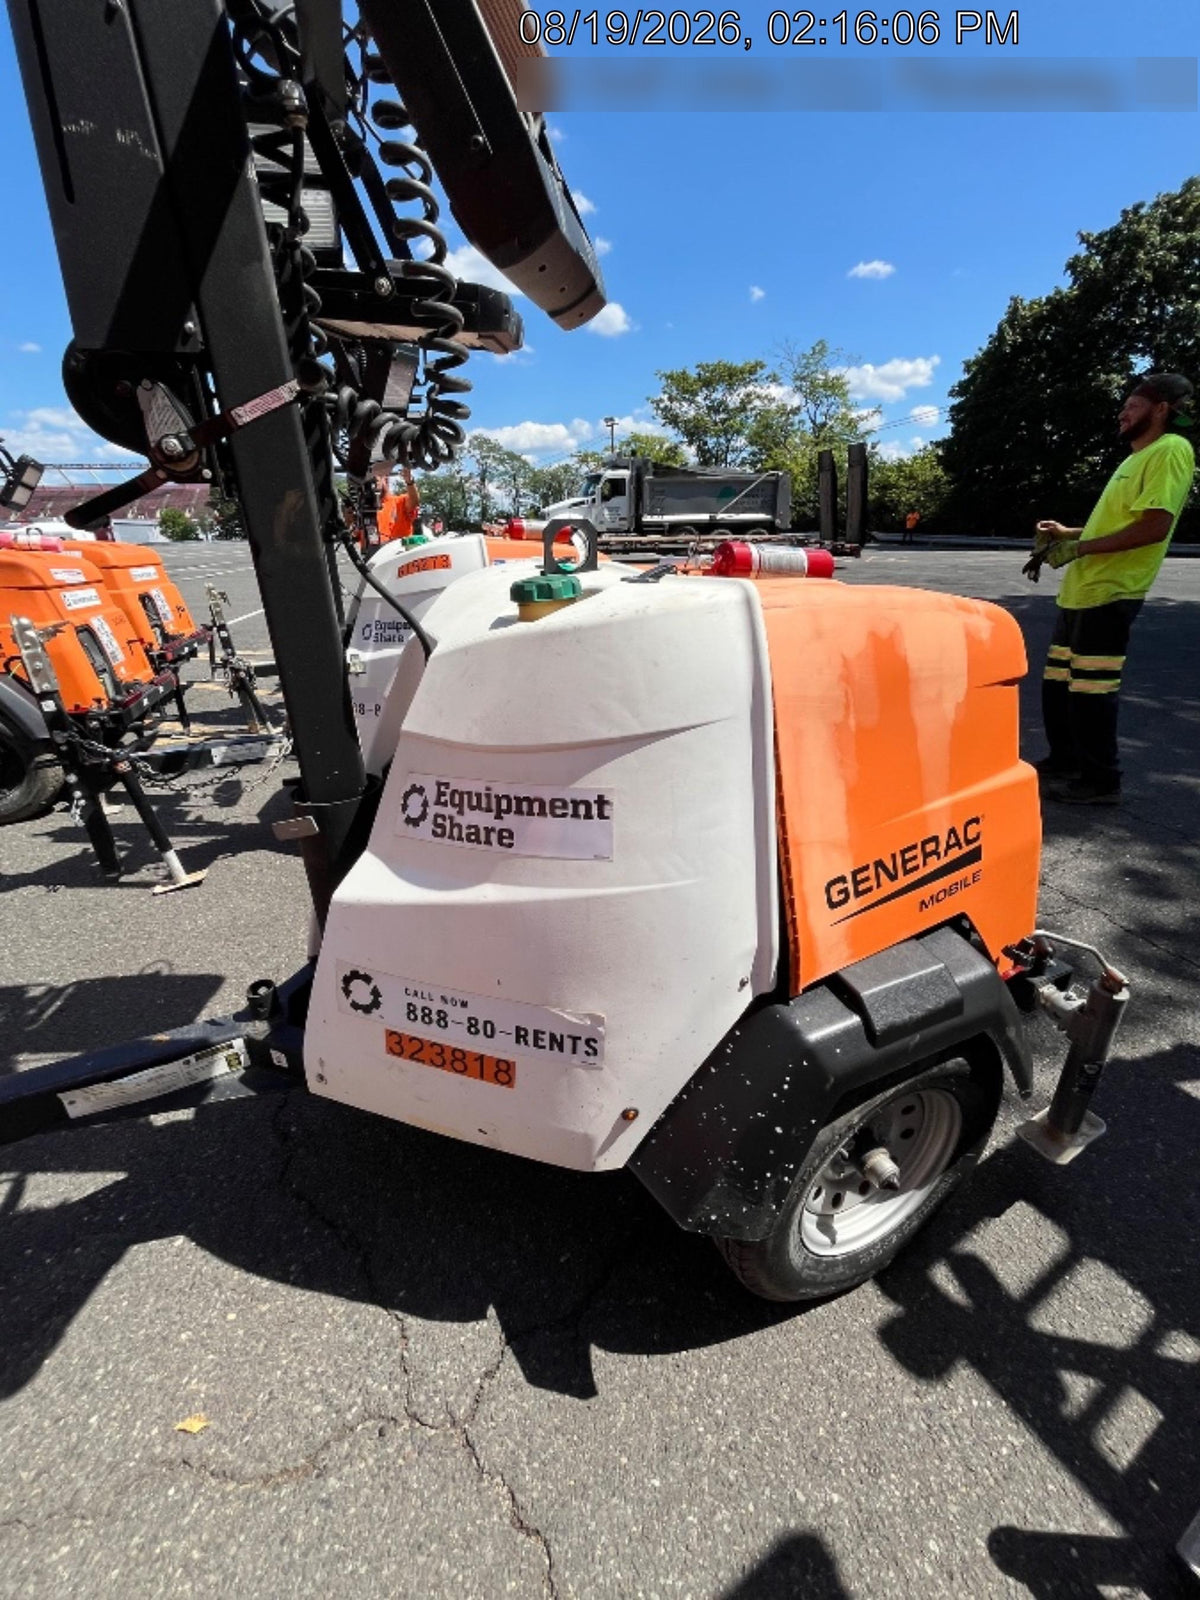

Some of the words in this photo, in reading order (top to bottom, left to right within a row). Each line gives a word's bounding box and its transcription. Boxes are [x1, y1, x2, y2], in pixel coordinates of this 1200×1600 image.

[434, 780, 613, 820] Equipment
[431, 813, 515, 848] Share
[824, 815, 982, 910] GENERAC
[919, 869, 982, 912] MOBILE
[404, 986, 434, 1002] CALL
[440, 995, 469, 1009] NOW
[405, 1002, 599, 1057] 888-80-RENTS
[387, 1031, 514, 1087] 323818
